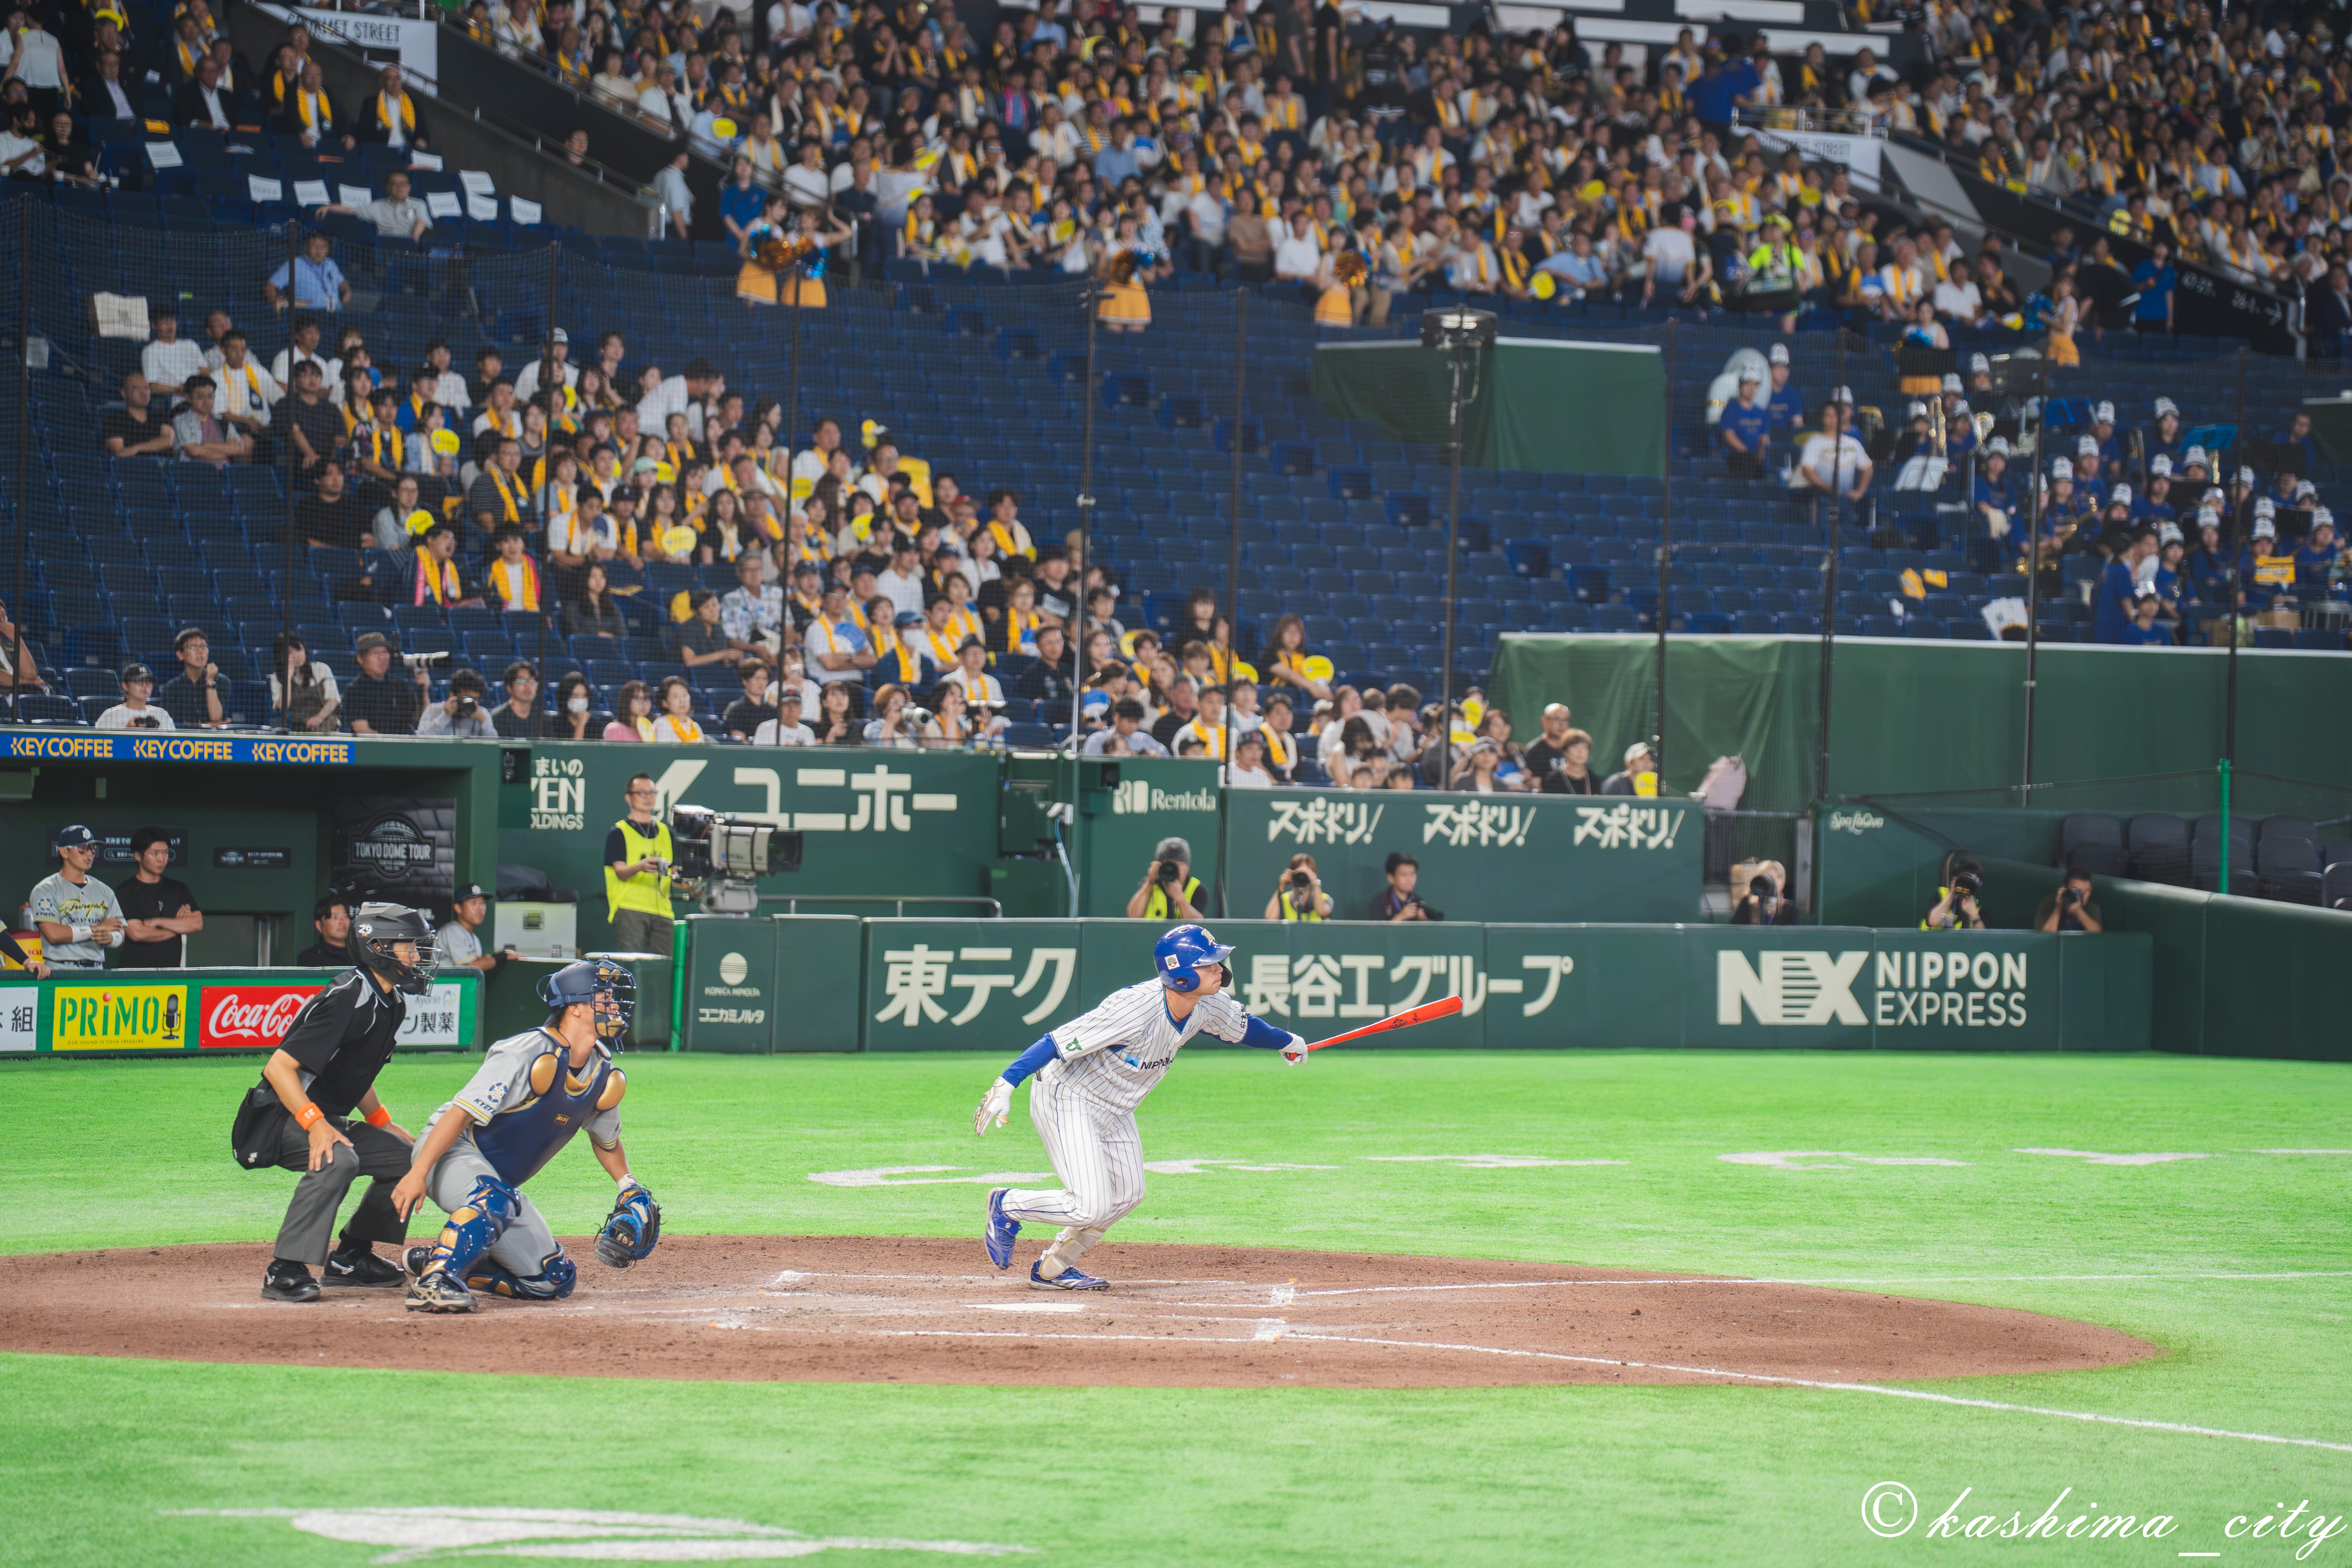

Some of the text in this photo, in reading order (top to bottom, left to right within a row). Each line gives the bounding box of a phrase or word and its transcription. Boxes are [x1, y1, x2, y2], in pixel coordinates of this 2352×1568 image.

[353, 21, 401, 42] STREET
[727, 764, 957, 832] ユニホー
[1151, 786, 1216, 812] Rentola
[355, 842, 431, 860] TOKYO DOME TOUR
[358, 924, 373, 934] 29
[1876, 951, 2027, 990] NIPPON
[875, 944, 1076, 1026] 東テク
[1243, 954, 1574, 1018] 長谷工グループ
[0, 1006, 33, 1032] 組
[698, 1008, 765, 1024] コニカミノルタ
[1876, 991, 2027, 1027] EXPRESS
